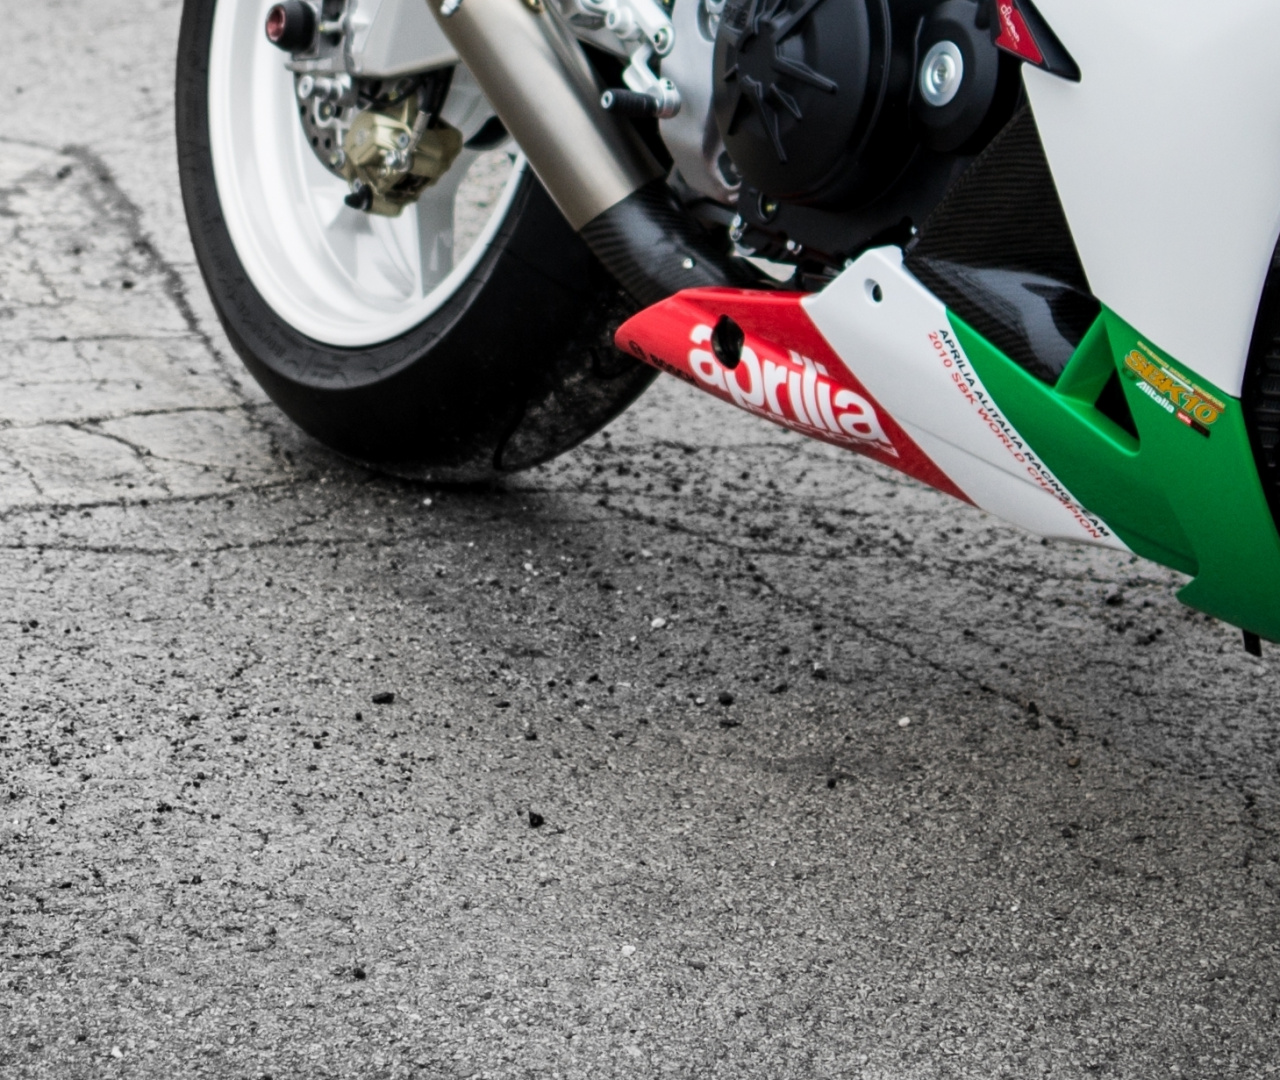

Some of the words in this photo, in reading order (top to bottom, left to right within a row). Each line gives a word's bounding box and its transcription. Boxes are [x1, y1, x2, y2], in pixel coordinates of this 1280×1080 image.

[688, 323, 893, 446] aprilia
[928, 331, 953, 368] 2010
[951, 372, 978, 405] SBK
[977, 408, 1026, 463] WORLD
[1027, 466, 1102, 539] CHAMPION
[939, 329, 976, 387] APRILIA
[974, 390, 1023, 449] ALITALIA
[1024, 452, 1071, 502] RACING
